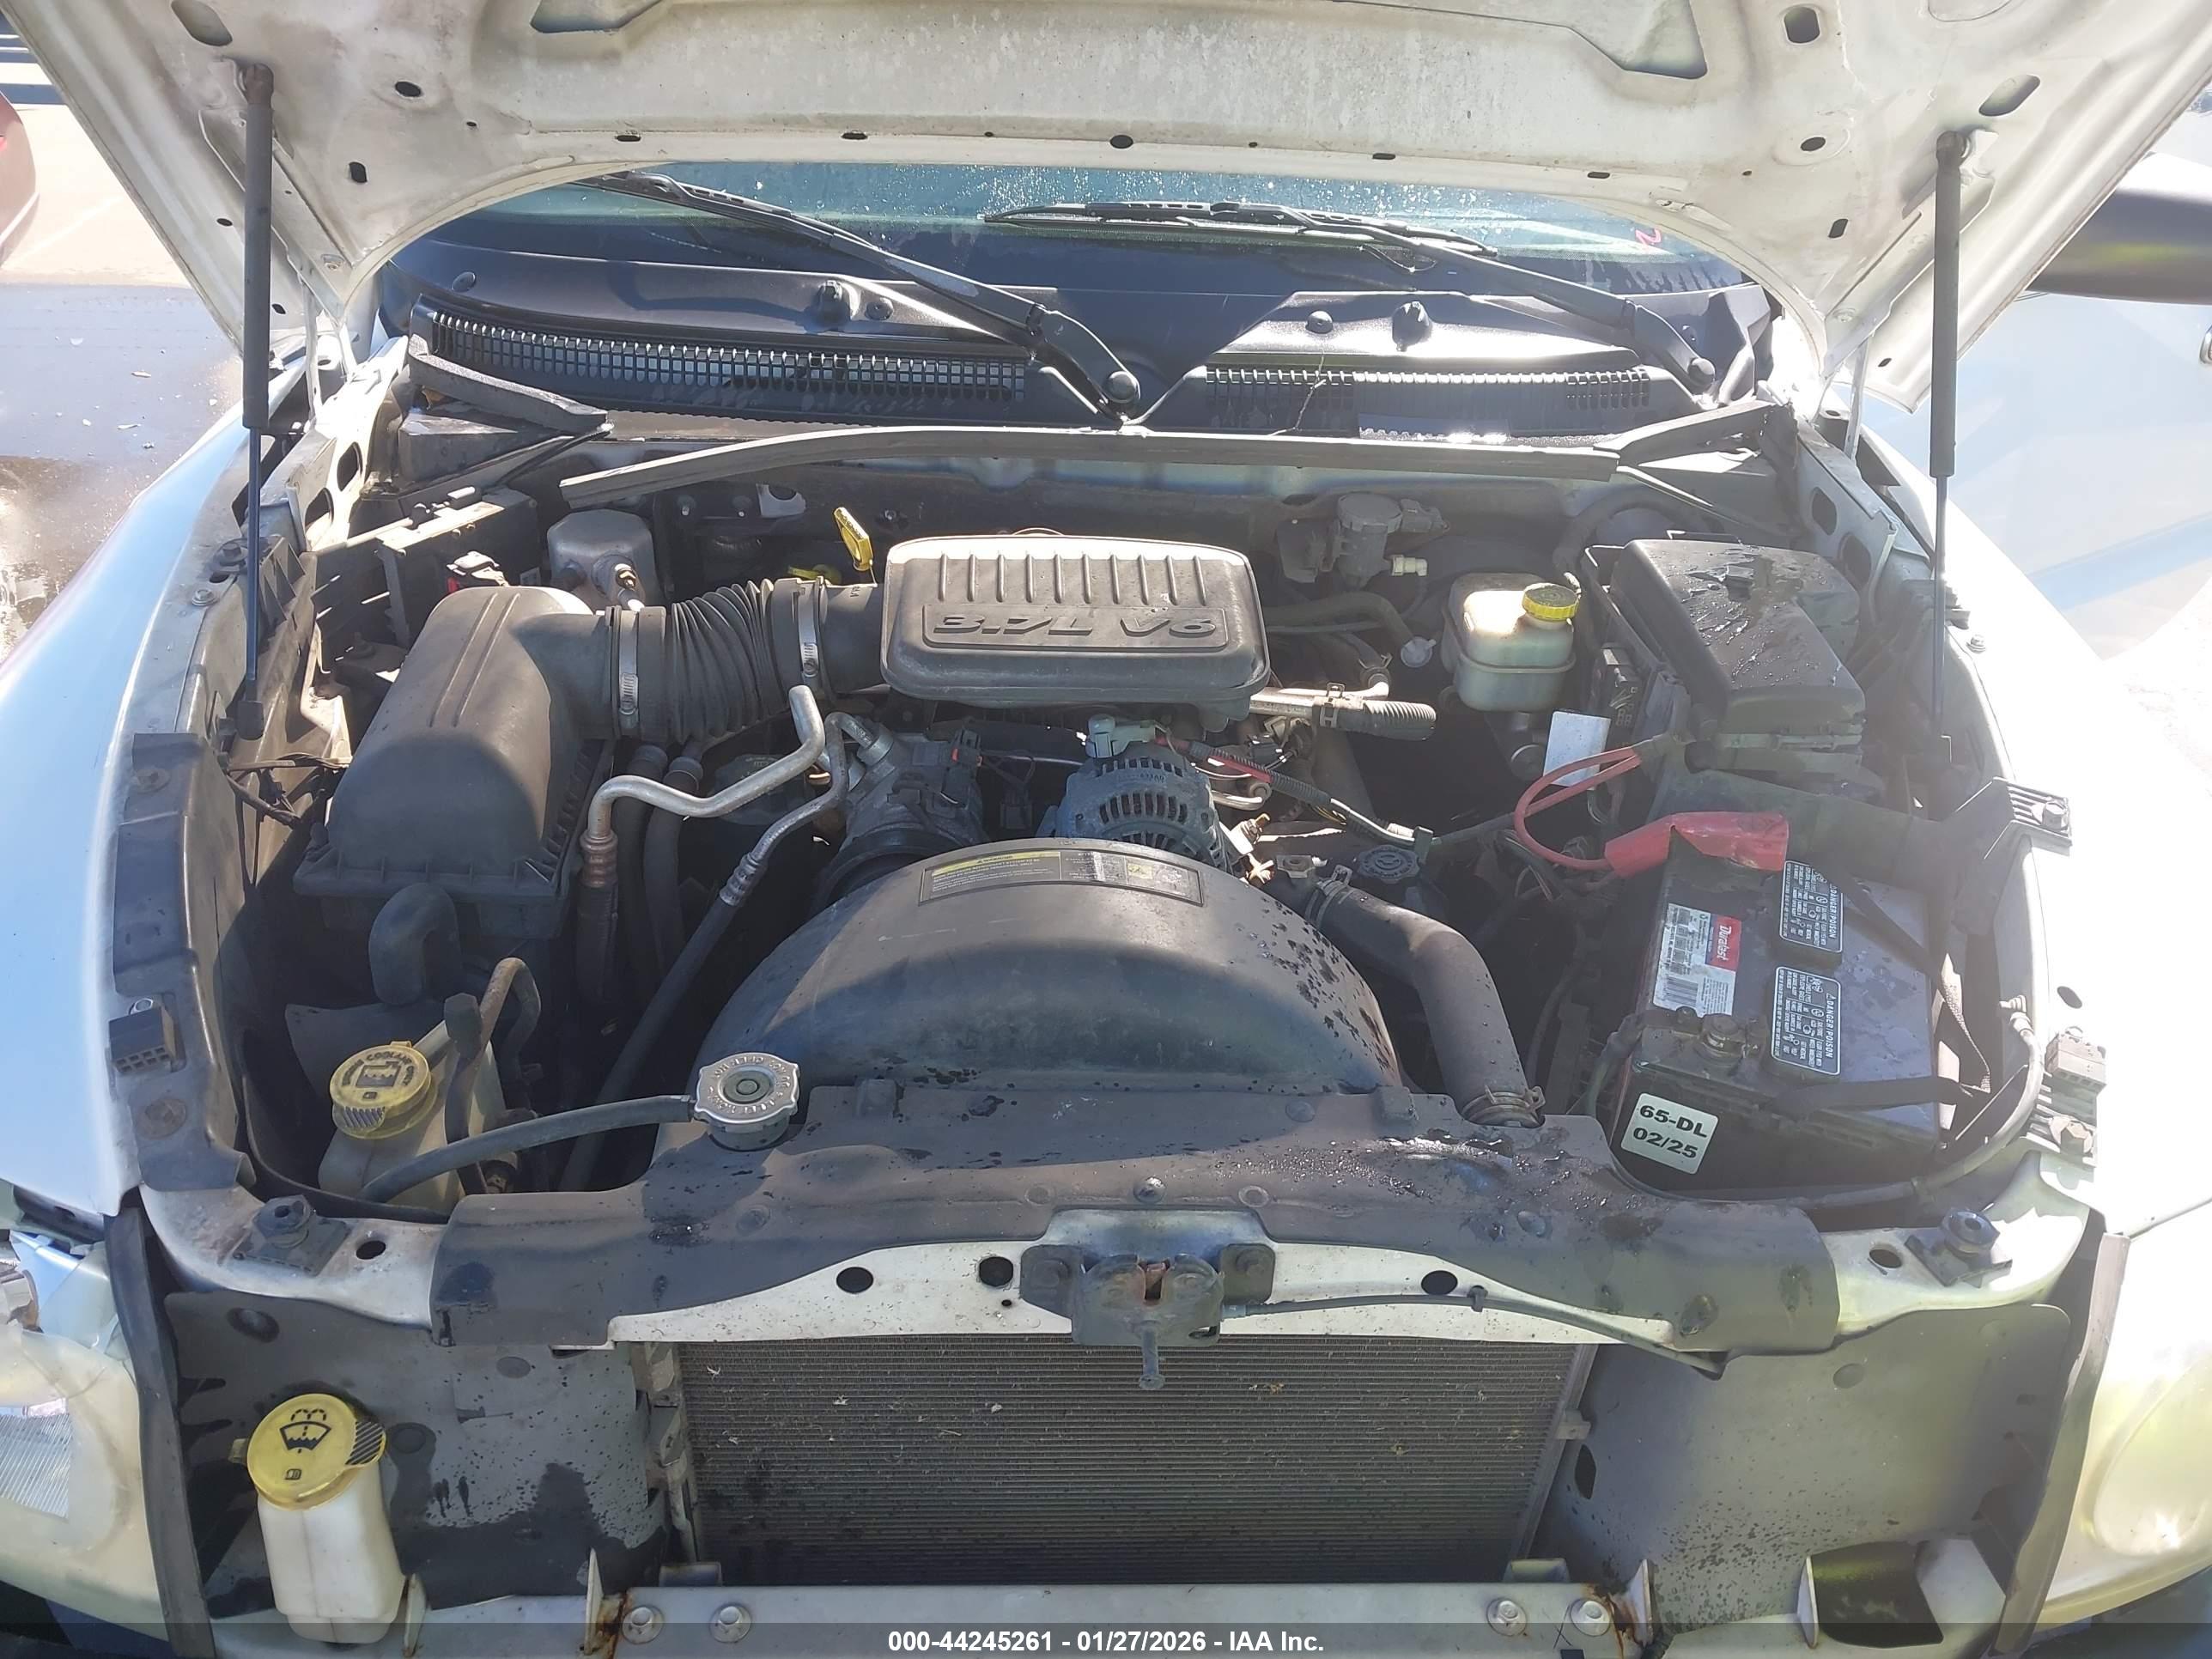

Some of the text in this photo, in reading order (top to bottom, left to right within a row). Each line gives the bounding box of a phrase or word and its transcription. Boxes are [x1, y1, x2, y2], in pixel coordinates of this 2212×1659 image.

[933, 616, 1217, 638] 3.7L V6
[1828, 888, 1838, 939] DANGER/POISON
[1717, 925, 1732, 961] Duralast
[1825, 1000, 1834, 1058] DANGER/POISON
[1640, 1105, 1707, 1138] 65-DL
[1633, 1127, 1698, 1158] 02/25
